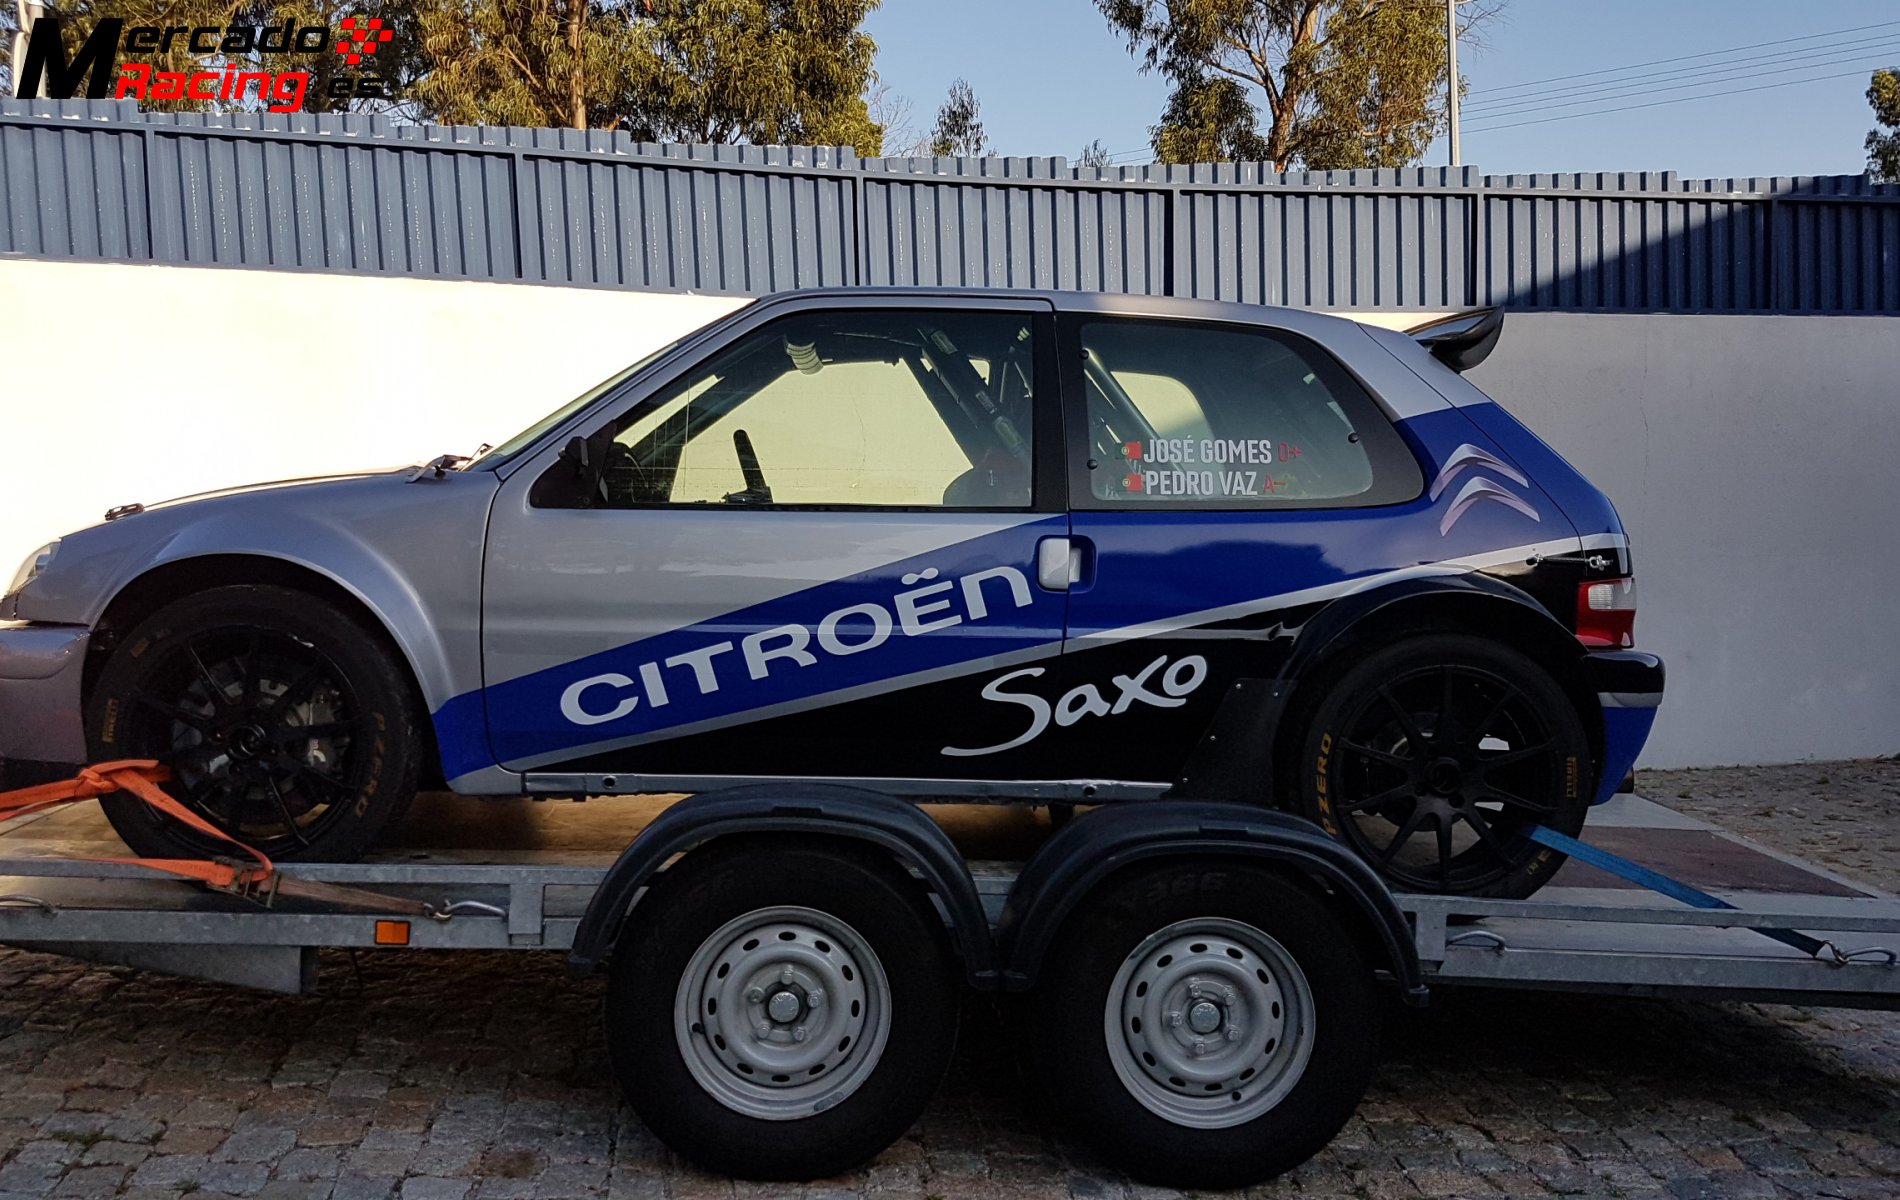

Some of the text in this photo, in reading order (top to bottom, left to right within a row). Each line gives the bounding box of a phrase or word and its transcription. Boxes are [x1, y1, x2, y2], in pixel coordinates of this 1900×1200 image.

[1143, 435, 1195, 463] JOSÉ
[1200, 439, 1272, 463] GOMES
[1145, 470, 1213, 495] PEDRO
[1219, 471, 1258, 495] VAZ
[941, 654, 1209, 757] Saxo
[1316, 732, 1333, 815] ZERO
